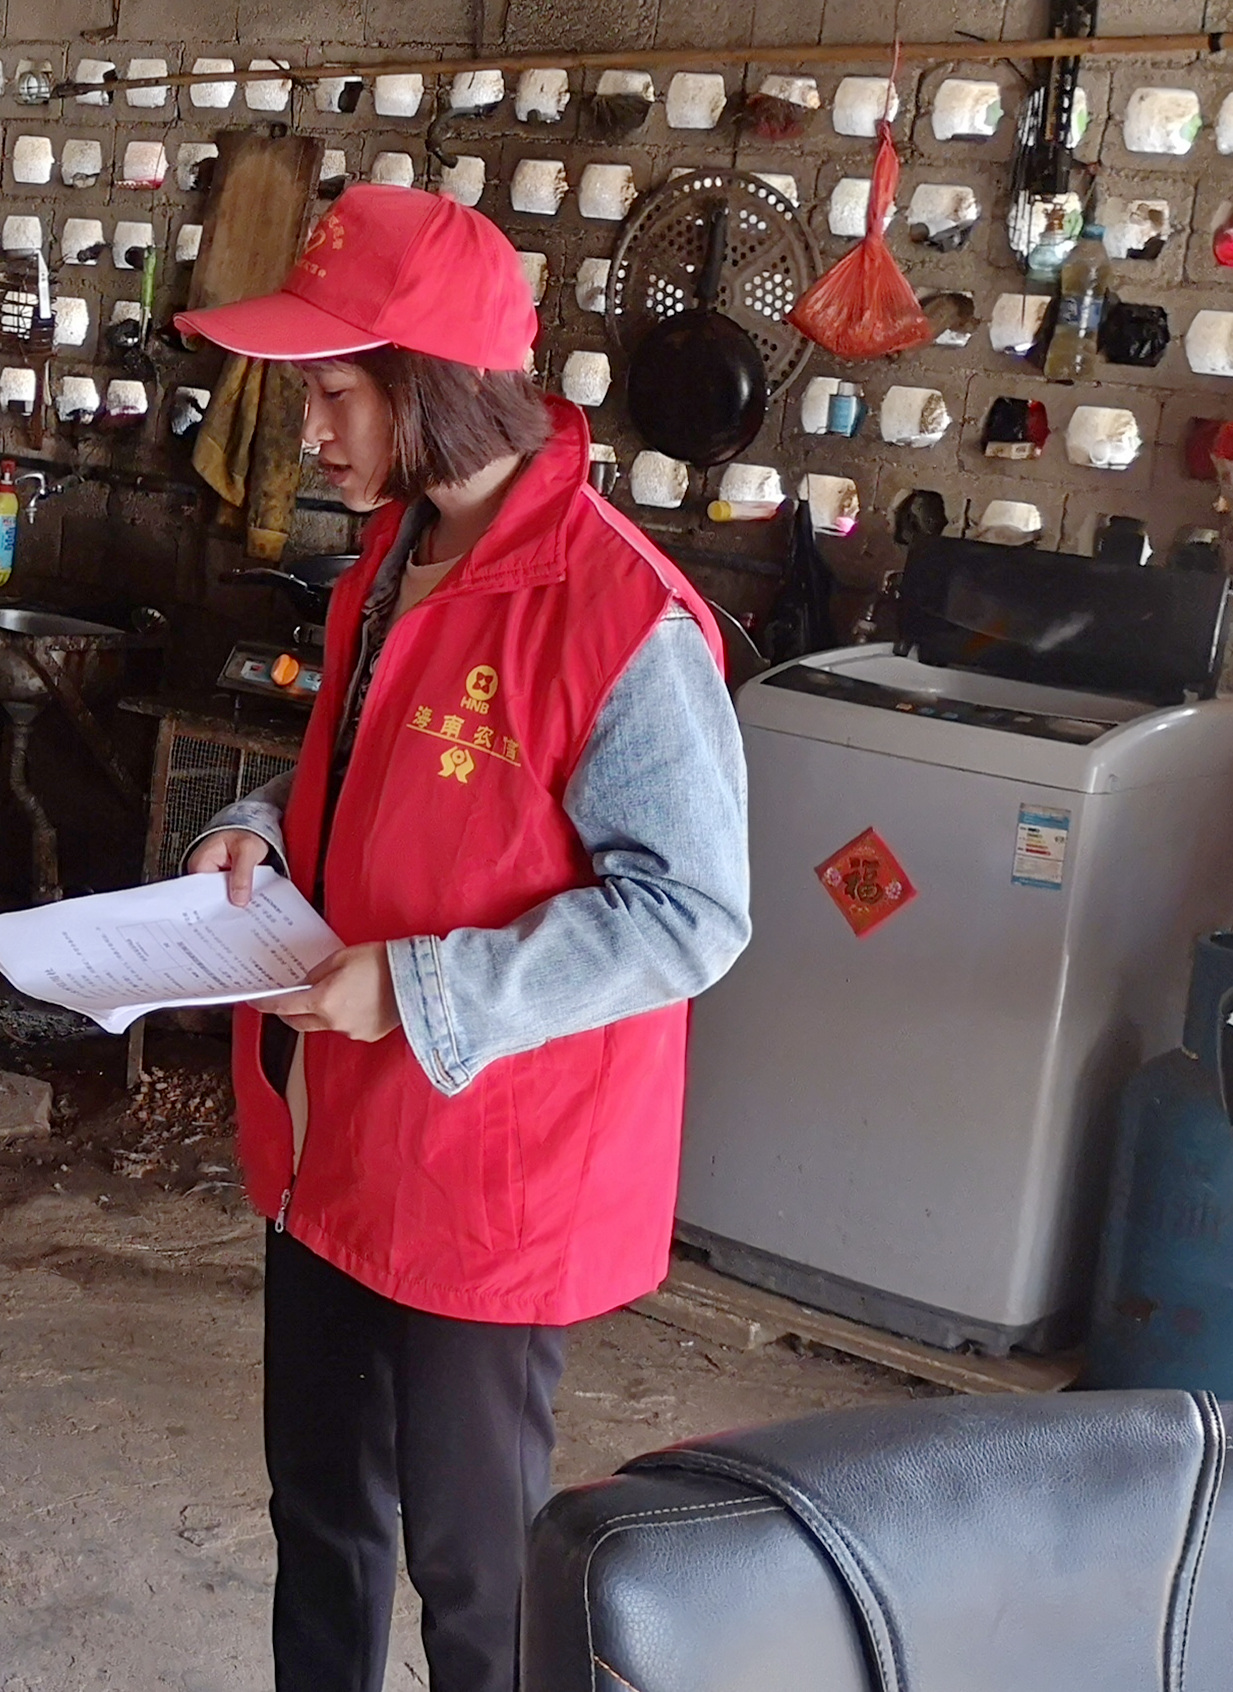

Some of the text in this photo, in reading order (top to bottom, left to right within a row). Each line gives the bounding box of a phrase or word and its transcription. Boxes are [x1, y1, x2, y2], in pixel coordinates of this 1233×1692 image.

[460, 696, 490, 714] HNB
[413, 706, 519, 760] 海南农信
[842, 856, 884, 904] 福
